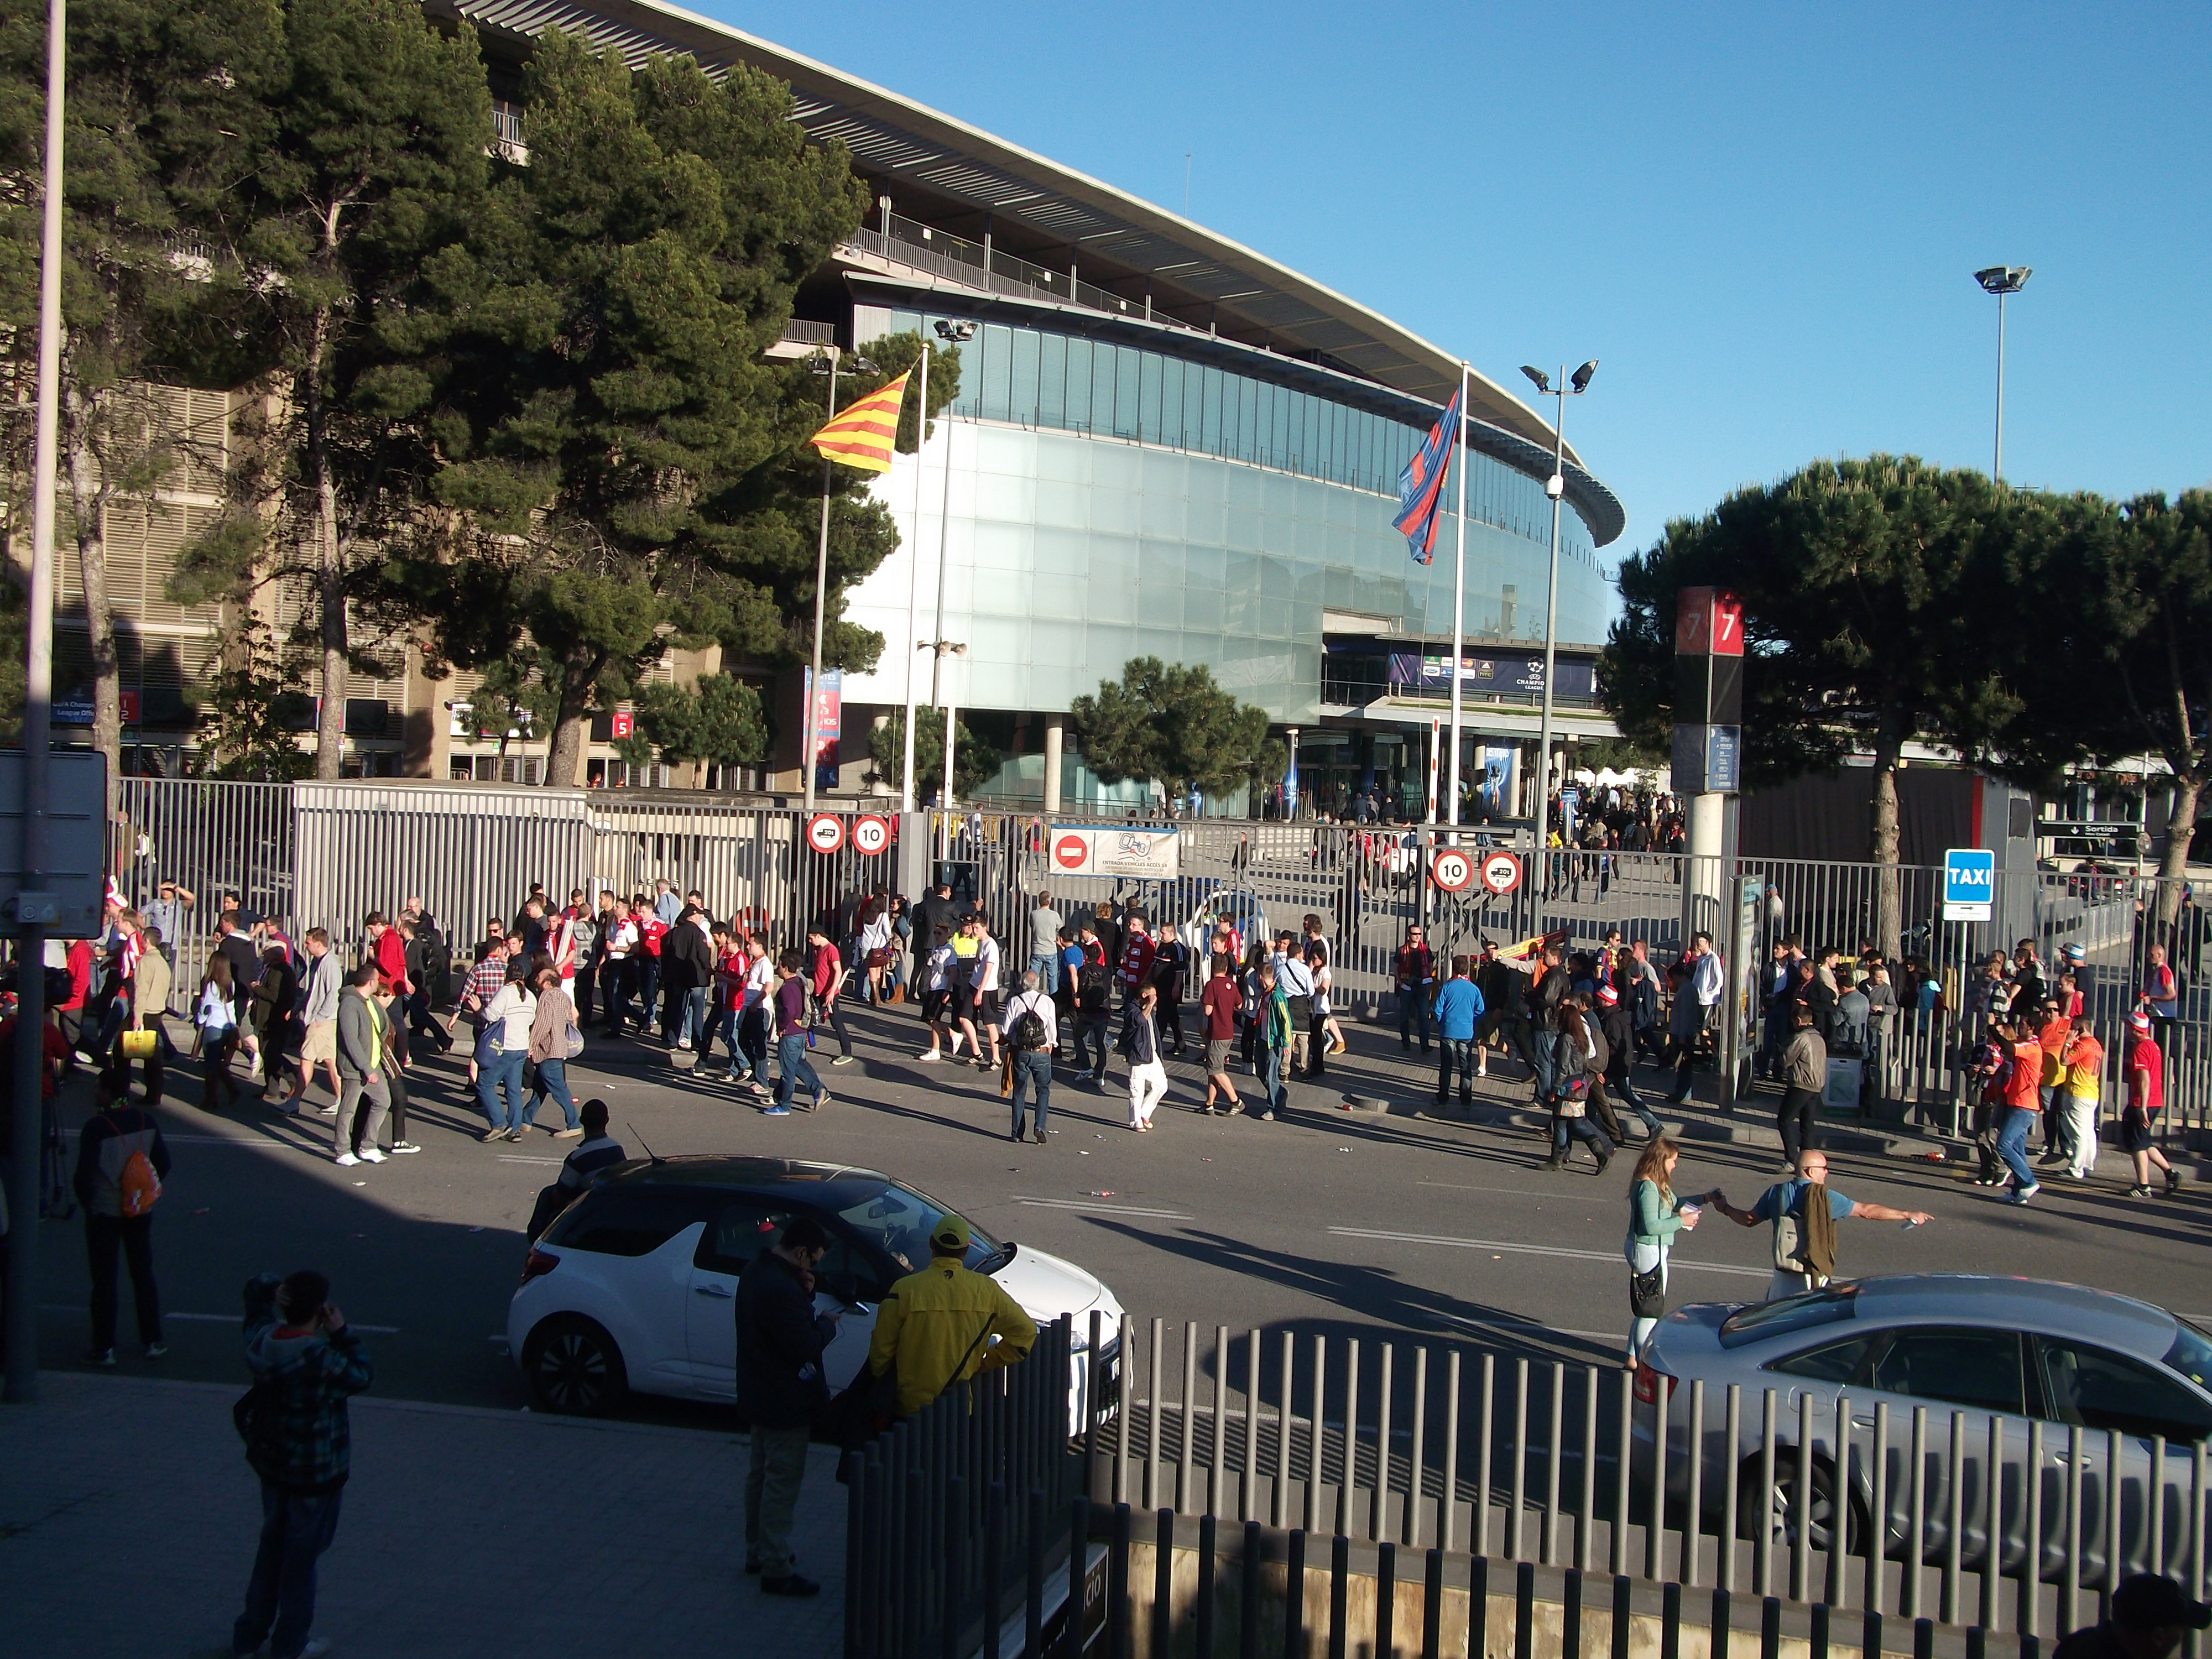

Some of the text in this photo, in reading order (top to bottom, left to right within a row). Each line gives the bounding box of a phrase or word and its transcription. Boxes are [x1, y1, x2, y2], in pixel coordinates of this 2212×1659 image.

[1688, 613, 1700, 639] 7
[1722, 613, 1734, 640] 7
[121, 710, 129, 719] 2
[619, 722, 627, 734] 5
[863, 829, 880, 842] 10
[1444, 864, 1462, 878] 10
[1949, 868, 1990, 885] TAXI
